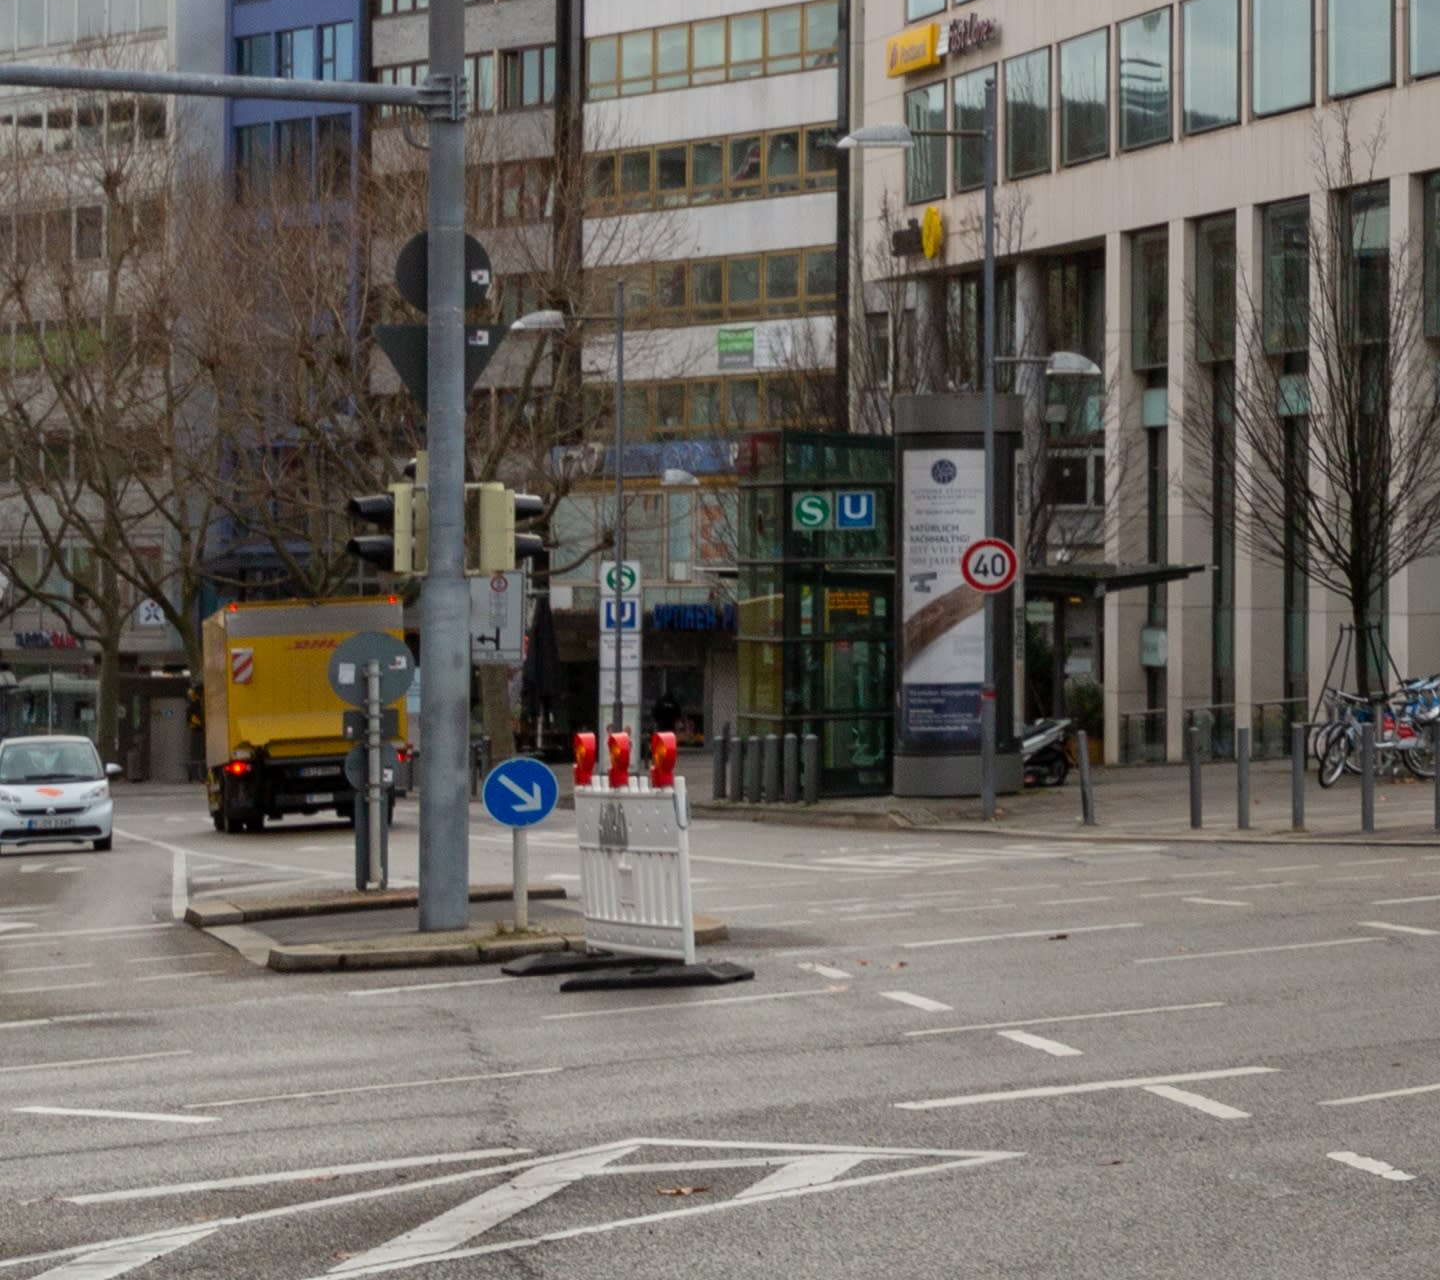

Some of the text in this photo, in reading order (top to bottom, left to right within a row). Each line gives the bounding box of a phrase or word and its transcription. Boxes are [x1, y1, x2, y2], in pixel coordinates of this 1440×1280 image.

[801, 495, 868, 526] S U
[973, 553, 1007, 578] 40
